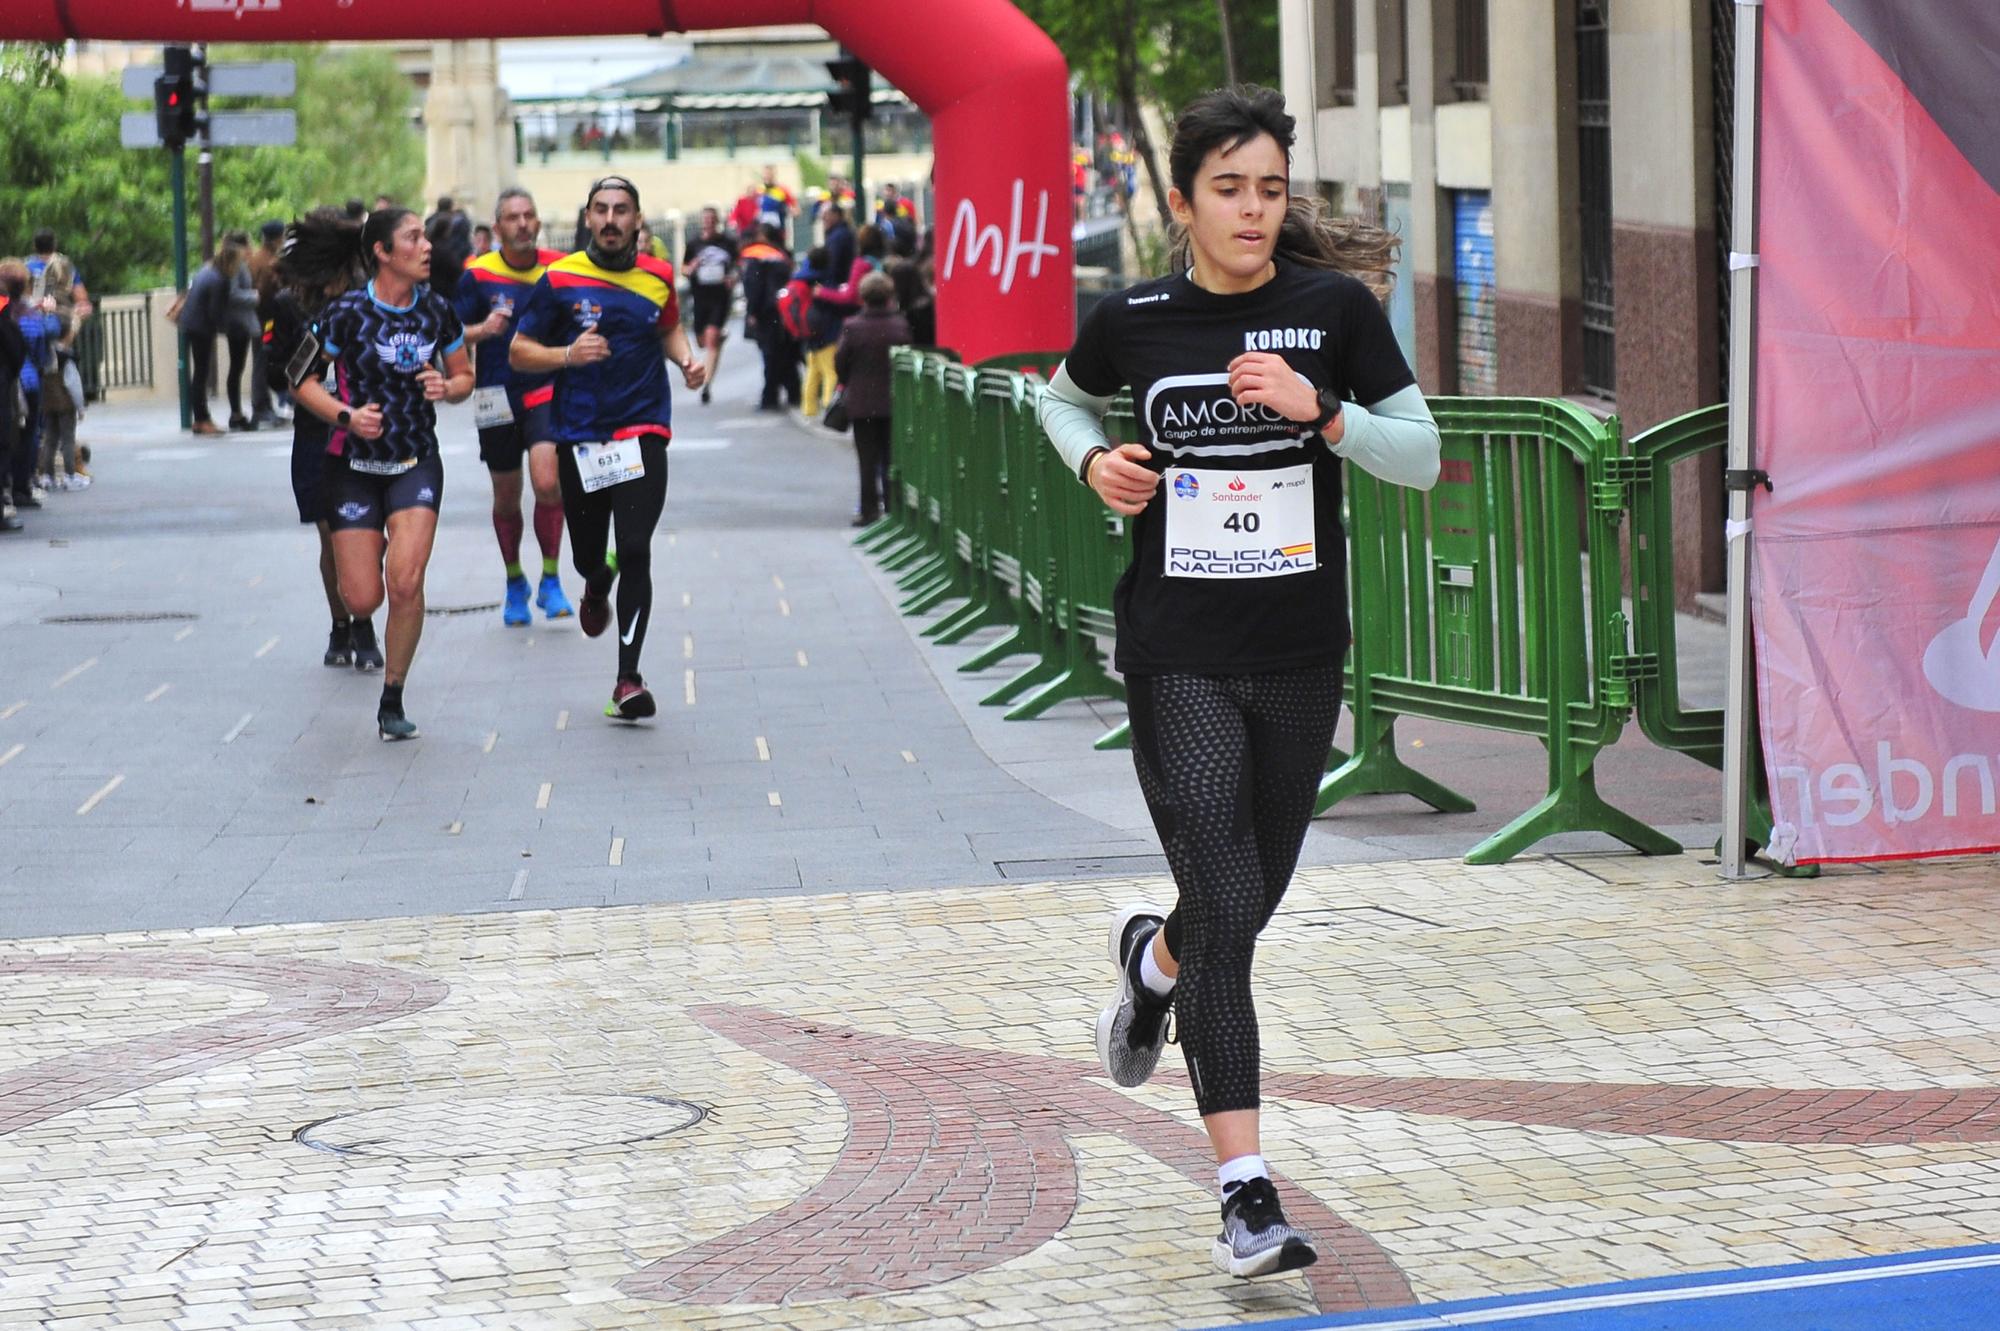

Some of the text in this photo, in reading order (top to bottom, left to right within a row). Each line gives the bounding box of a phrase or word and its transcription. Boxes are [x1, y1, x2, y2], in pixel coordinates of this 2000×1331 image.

[1164, 428, 1198, 441] Grupo
[1200, 426, 1216, 436] de
[1212, 492, 1263, 502] Santander
[1223, 511, 1261, 533] 40
[1170, 547, 1286, 561] POLICIA
[1170, 558, 1314, 574] NACIONAL
